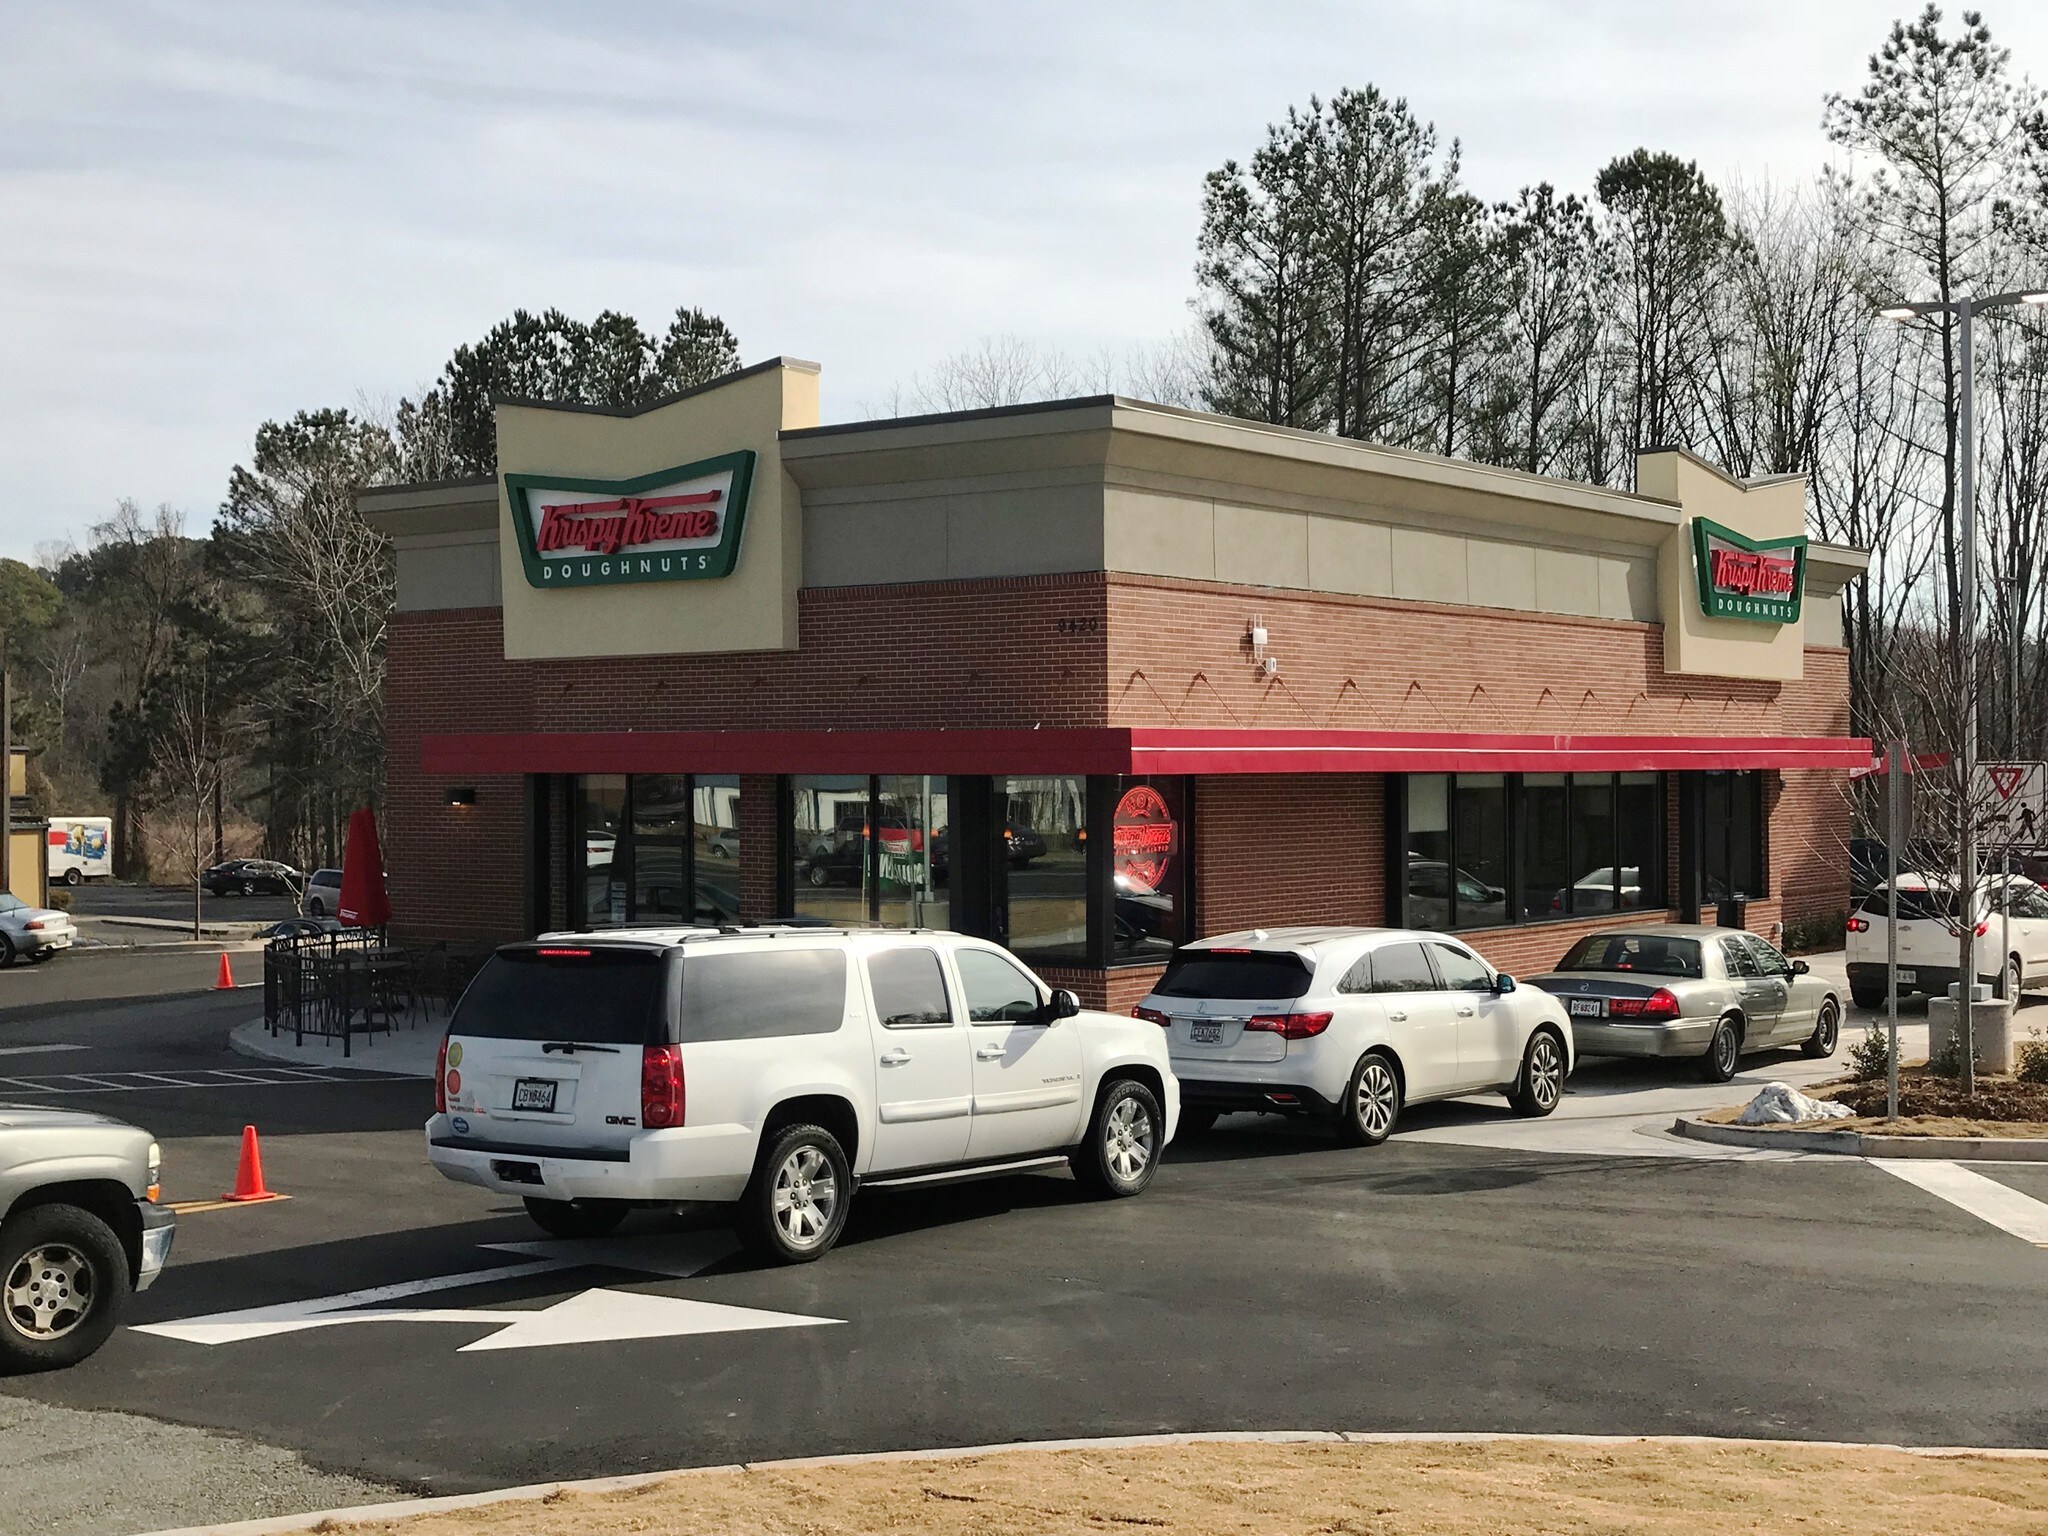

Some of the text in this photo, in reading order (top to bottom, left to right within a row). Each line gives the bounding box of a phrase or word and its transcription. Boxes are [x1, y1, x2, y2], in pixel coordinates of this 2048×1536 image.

[536, 490, 722, 554] Krispy Kreme
[543, 555, 707, 580] DOUGHNUTS
[1711, 549, 1795, 596] Krispy Kreme
[1718, 598, 1792, 618] DOUGHNUTS
[1125, 793, 1155, 814] HOT
[605, 1115, 637, 1126] GMC
